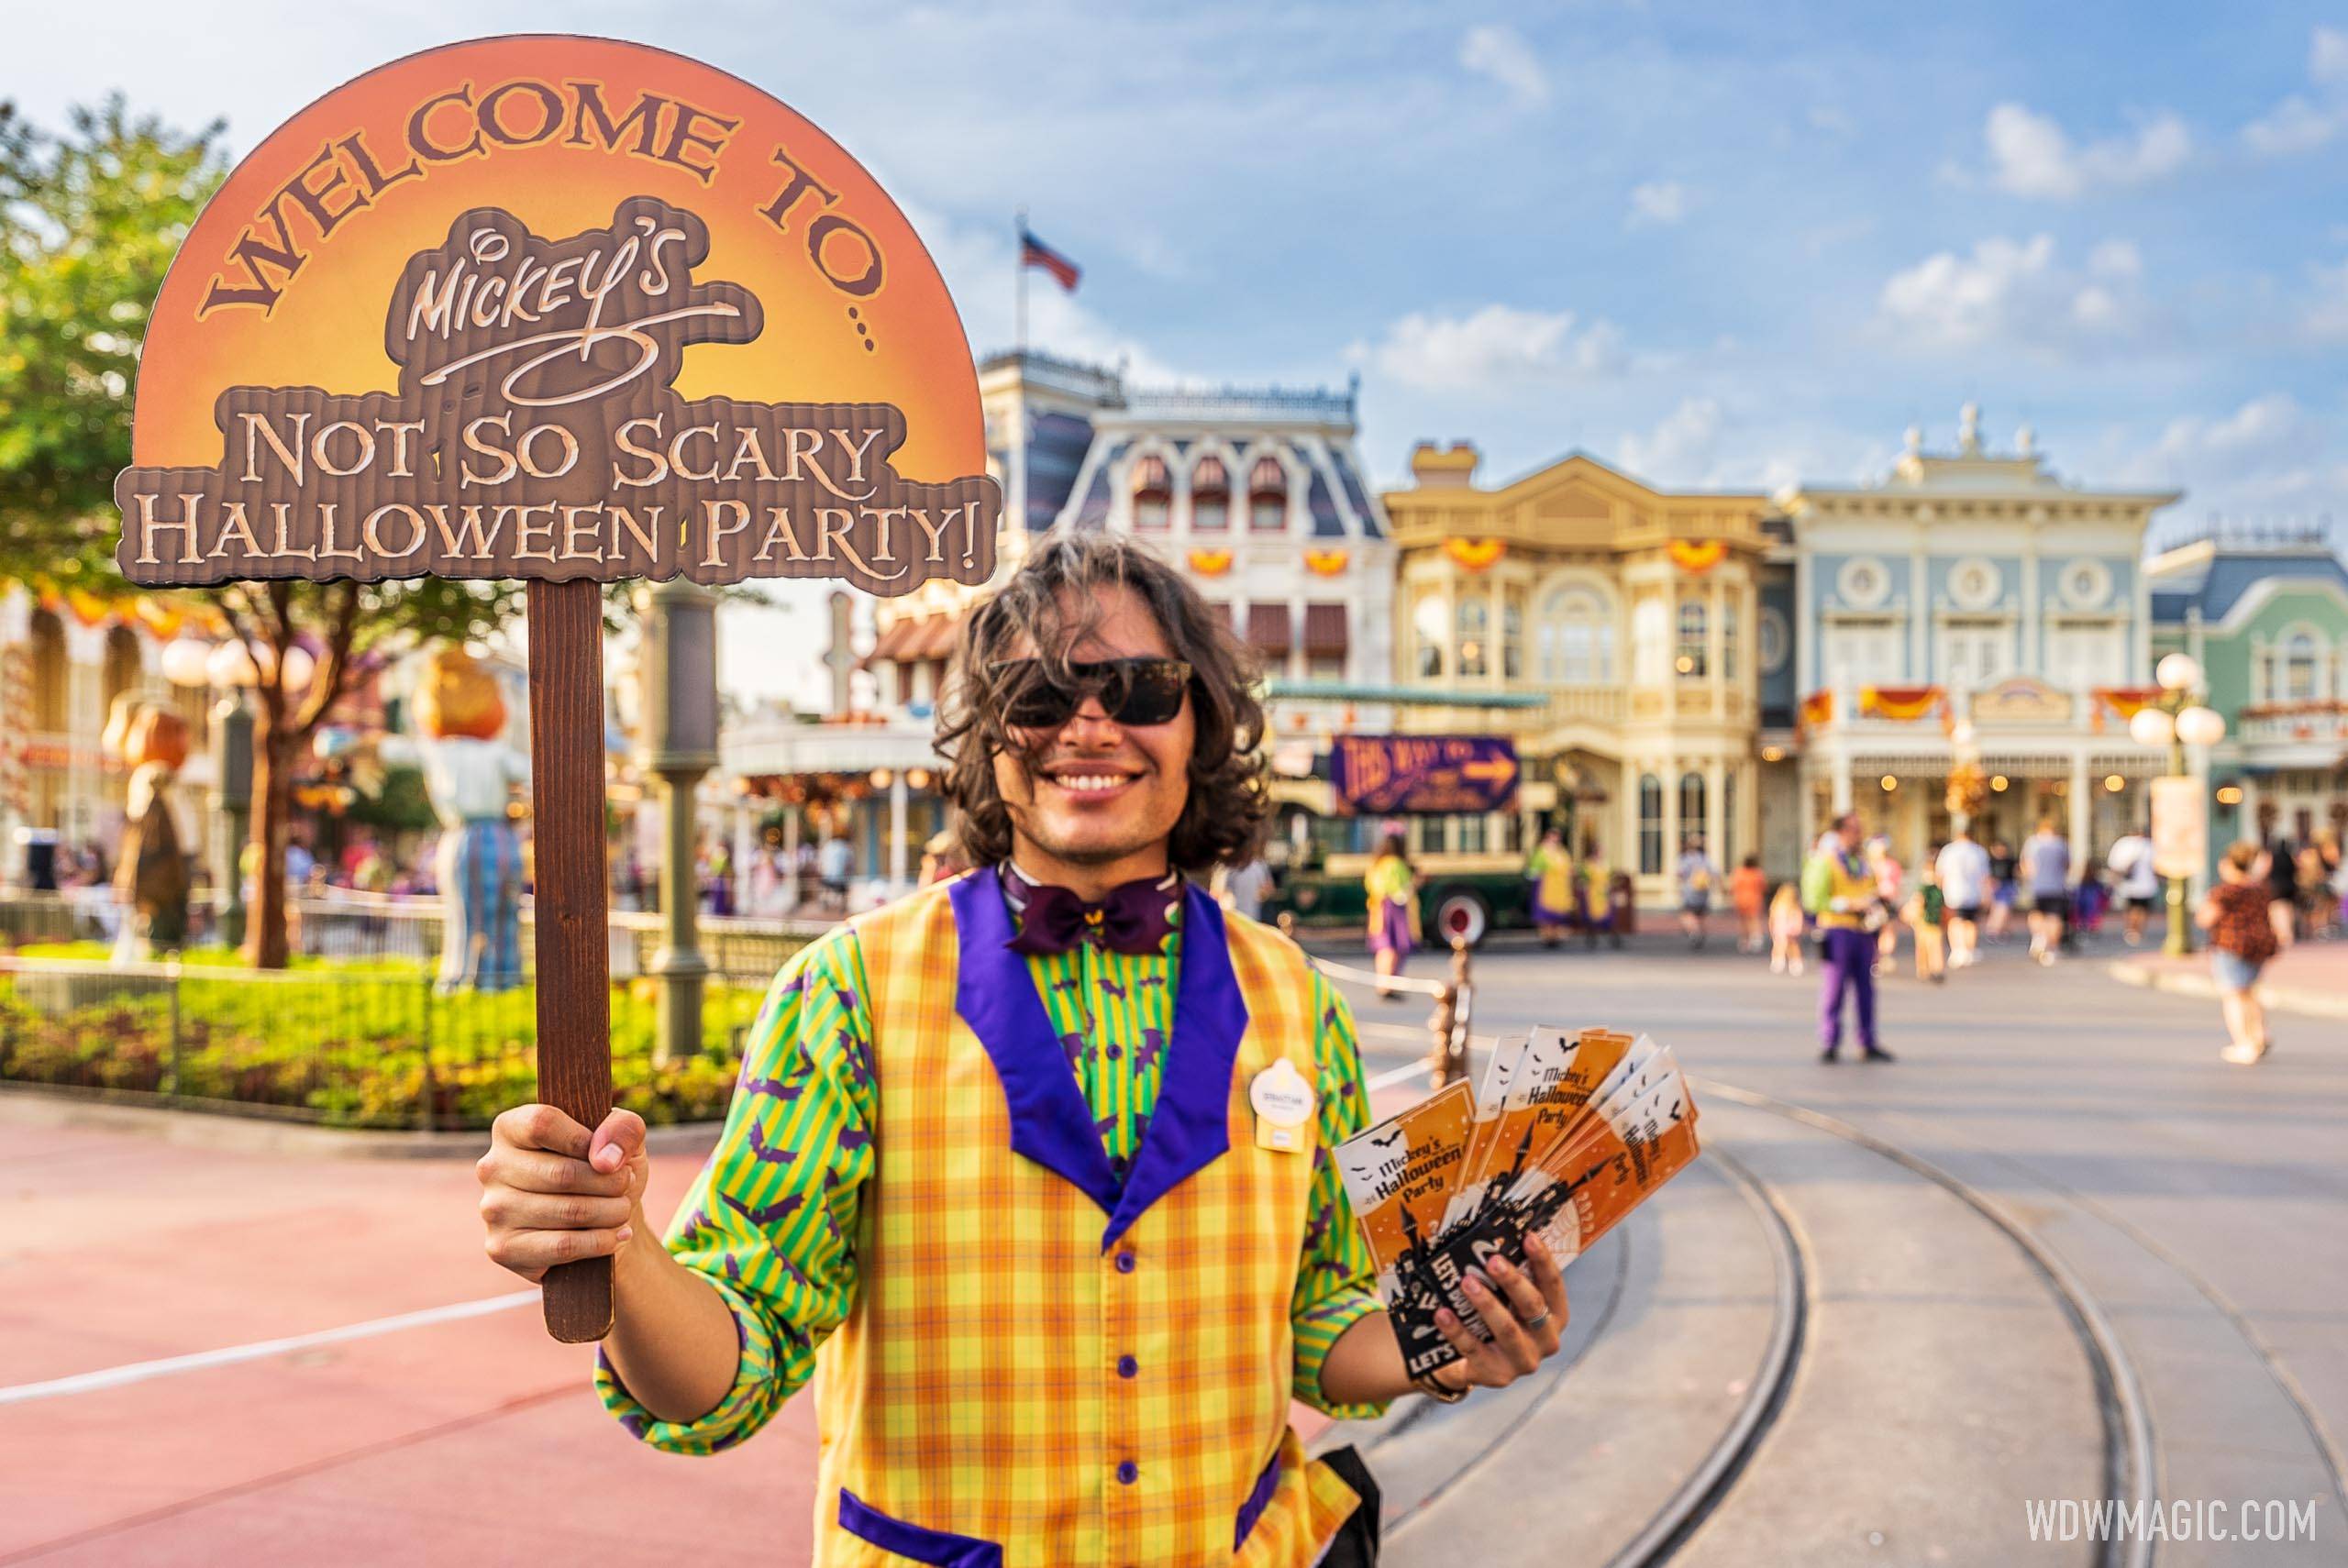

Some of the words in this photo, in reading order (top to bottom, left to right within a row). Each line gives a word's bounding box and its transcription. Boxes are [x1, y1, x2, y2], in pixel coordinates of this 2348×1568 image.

[199, 80, 739, 318] WELCOME
[238, 413, 426, 487] NOT
[460, 409, 580, 490] SO
[613, 412, 884, 502] SCARY
[134, 491, 664, 565] HALLOWEEN
[700, 499, 978, 580] PARTY!
[1375, 1149, 1462, 1199] Halloween
[1379, 1136, 1442, 1177] Mickey's
[1402, 1176, 1445, 1203] Party
[1431, 1253, 1461, 1291] LET'S
[1409, 1342, 1456, 1374] LET'S
